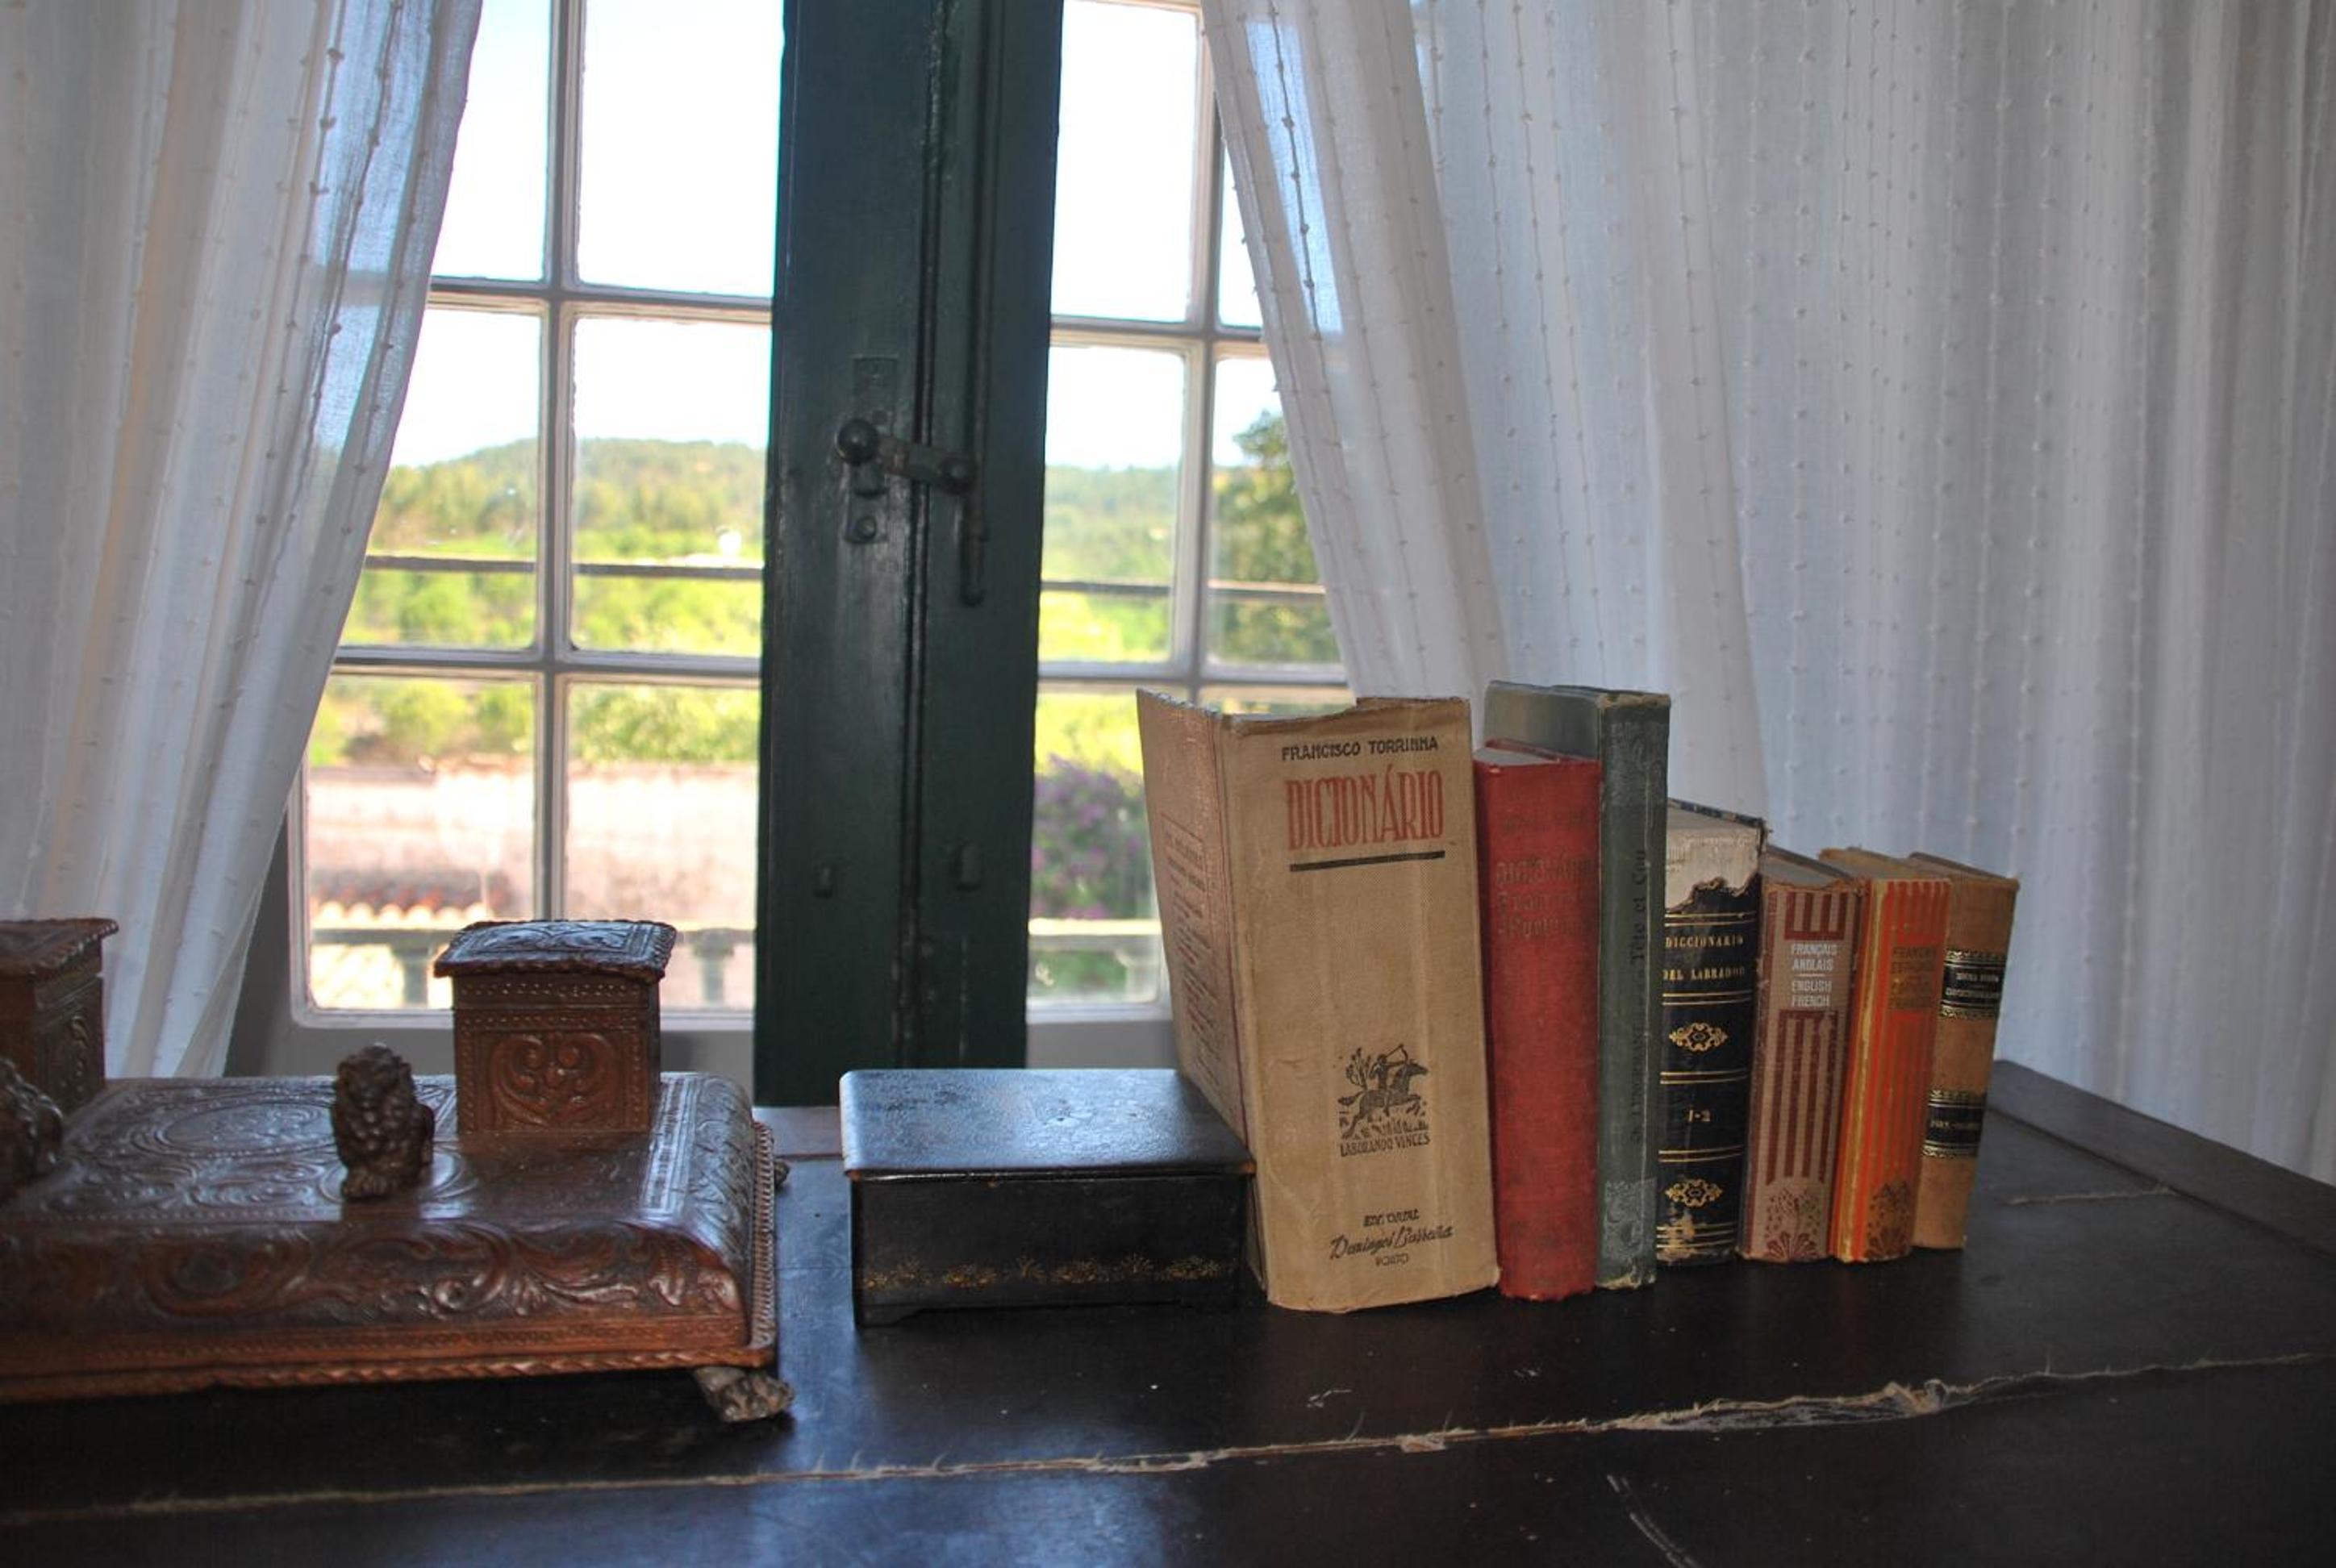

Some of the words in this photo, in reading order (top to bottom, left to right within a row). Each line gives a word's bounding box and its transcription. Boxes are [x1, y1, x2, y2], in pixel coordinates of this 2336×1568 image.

[1282, 741, 1361, 761] FRANCISCO
[1368, 736, 1439, 755] TORRINHA
[1284, 763, 1445, 852] DICIONÁRIO
[1791, 943, 1838, 957] FRANÇAIS
[1792, 958, 1833, 971] ANGLAIS
[1792, 979, 1833, 993] ENGLISH
[1792, 995, 1830, 1007] FRENCH
